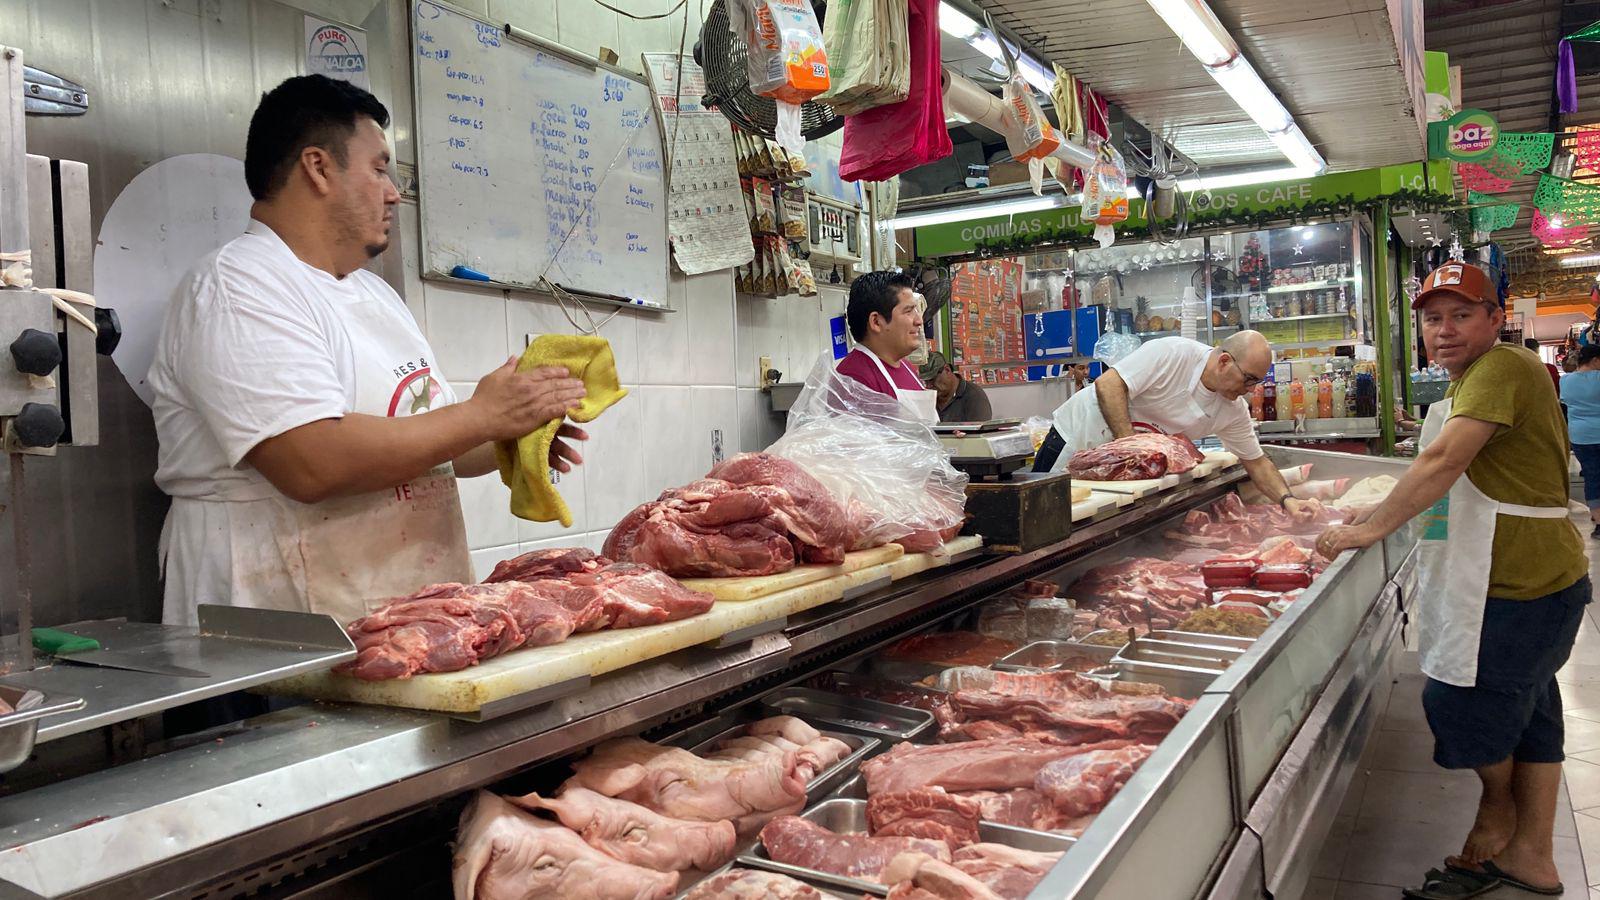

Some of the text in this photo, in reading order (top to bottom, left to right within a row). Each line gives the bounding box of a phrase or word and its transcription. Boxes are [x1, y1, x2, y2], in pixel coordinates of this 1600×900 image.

[317, 29, 347, 43] PURO
[570, 103, 588, 118] 210
[1448, 124, 1494, 143] baz
[1399, 174, 1438, 192] L-C1
[960, 218, 1042, 242] COMIDAS
[1137, 193, 1239, 220] LADOS
[1255, 183, 1312, 205] CAFE
[833, 333, 846, 346] VISA
[393, 357, 429, 379] RES &
